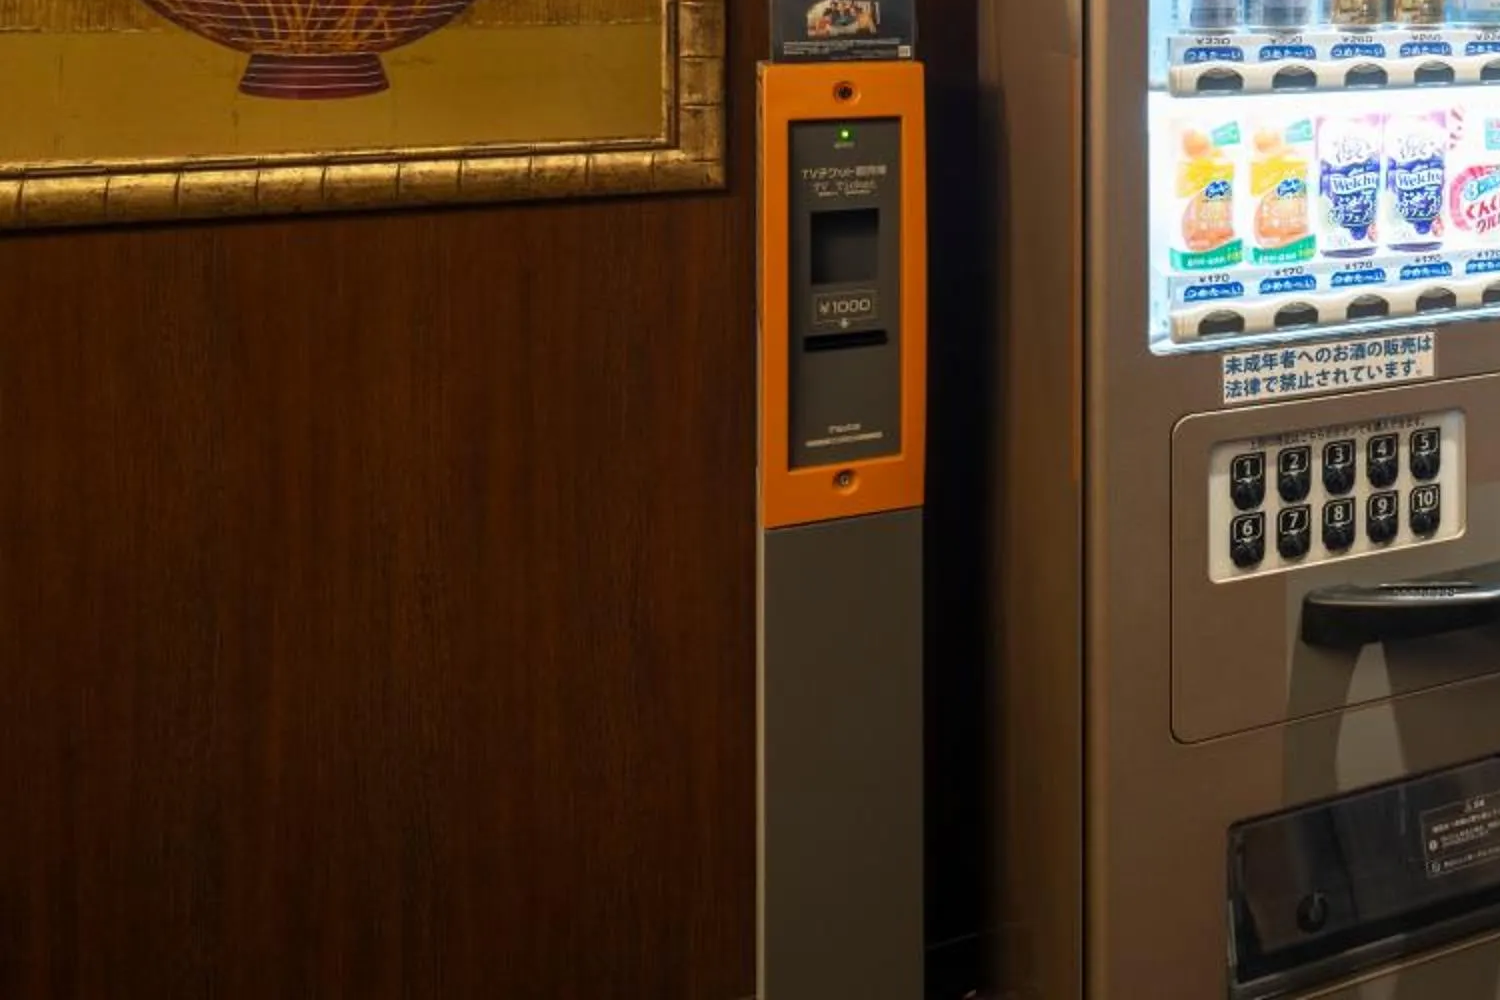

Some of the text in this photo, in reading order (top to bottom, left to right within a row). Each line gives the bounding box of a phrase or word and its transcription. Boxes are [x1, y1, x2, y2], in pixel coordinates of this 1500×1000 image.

[819, 297, 871, 315] ¥1000
[1224, 335, 1432, 374] 未成年者へのお酒の販売は
[1225, 362, 1423, 399] 法律で禁止されています。
[1377, 440, 1388, 456] 4
[1420, 435, 1429, 450] 5
[1289, 453, 1300, 469] 2
[1334, 447, 1344, 463] 3
[1243, 461, 1252, 477] 1
[1377, 498, 1388, 514] 9
[1418, 491, 1434, 508] 10
[1289, 513, 1300, 529] 7
[1334, 505, 1344, 521] 8
[1243, 520, 1253, 537] 6
